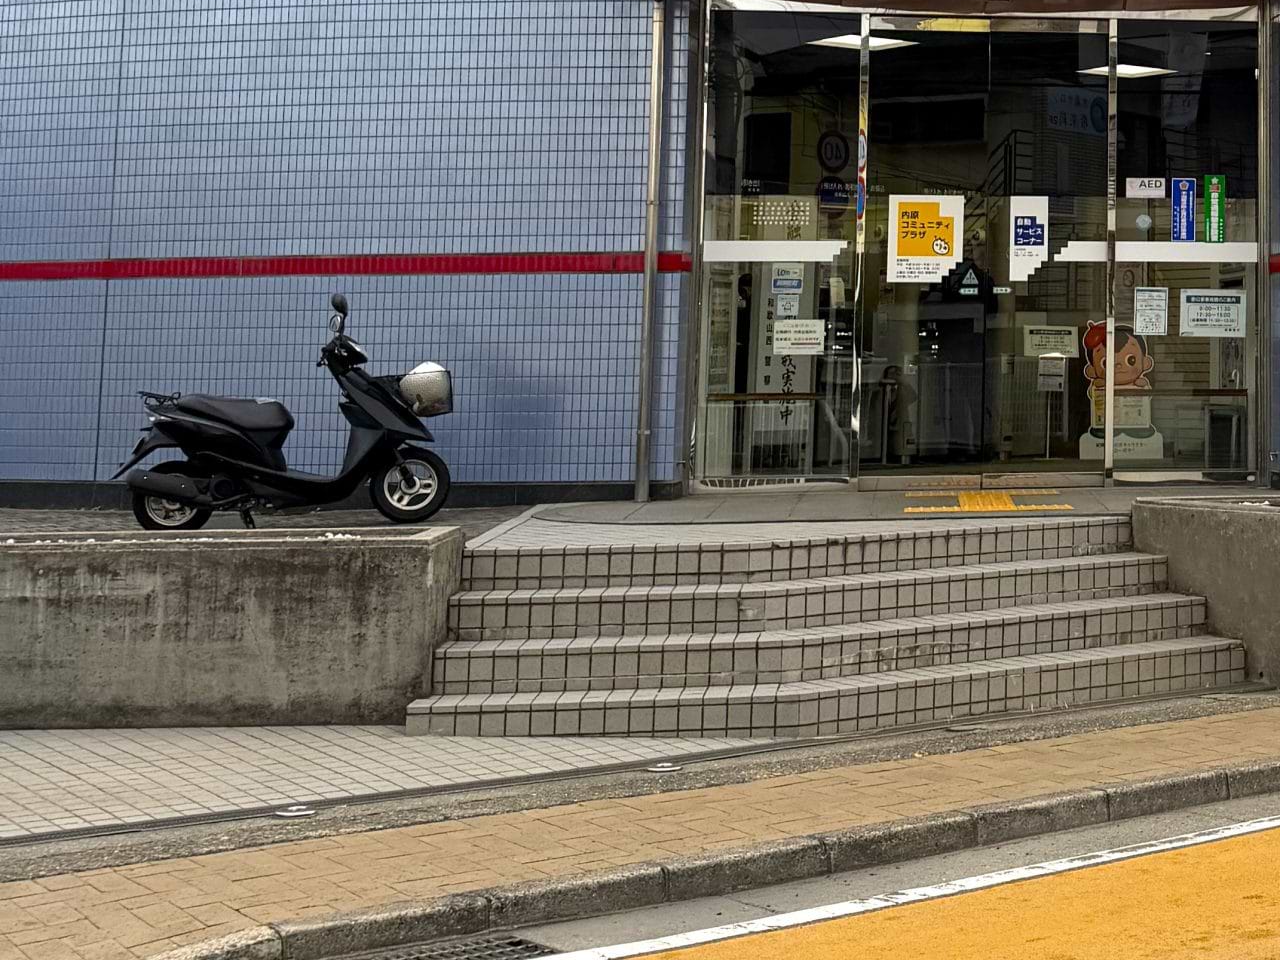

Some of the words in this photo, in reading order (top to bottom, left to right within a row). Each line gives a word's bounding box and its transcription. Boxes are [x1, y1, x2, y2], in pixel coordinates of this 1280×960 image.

[1138, 180, 1162, 189] AED
[901, 211, 919, 219] 内原
[901, 221, 951, 229] コミュニティ
[901, 231, 927, 239] プラザ
[1016, 227, 1042, 235] サービス
